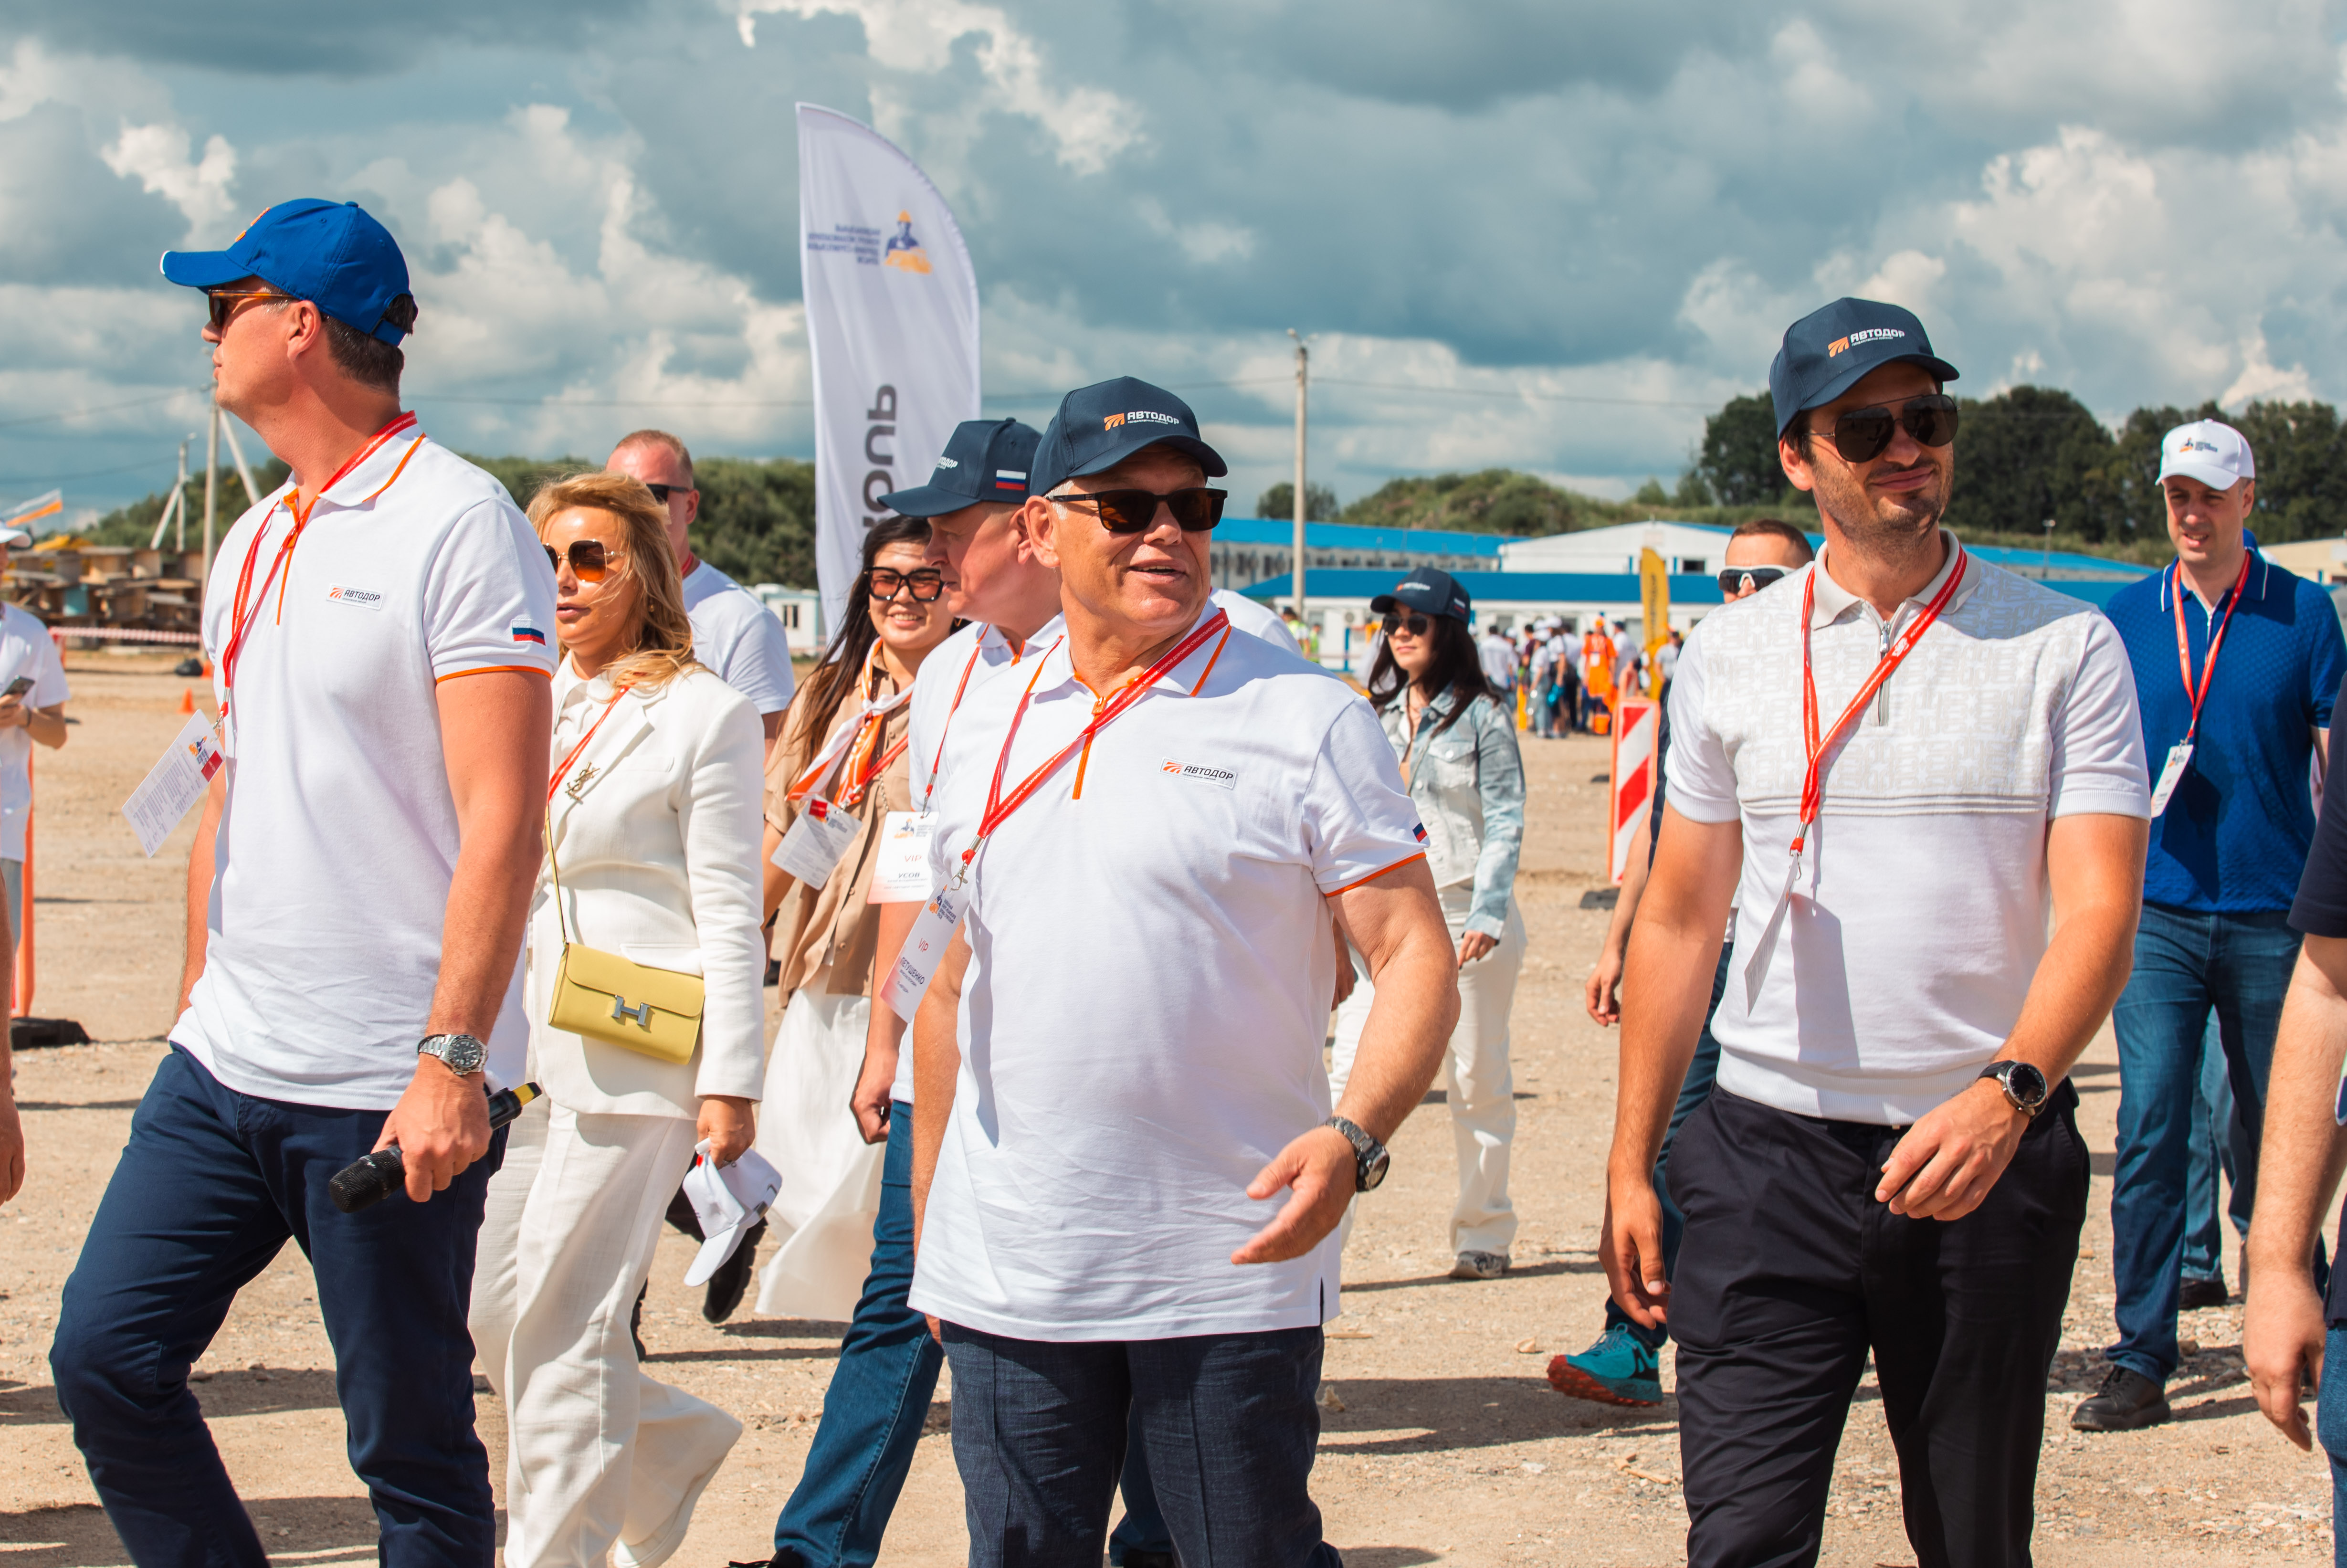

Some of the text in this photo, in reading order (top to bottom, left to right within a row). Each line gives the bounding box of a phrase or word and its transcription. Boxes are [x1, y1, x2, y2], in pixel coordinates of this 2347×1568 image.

[1850, 328, 1905, 343] АВТОДОР
[1127, 411, 1179, 425] АВТОДОР
[344, 589, 380, 601] АВТОДОР
[1095, 698, 1127, 726] НАЦИОНАЛЬНЫЙ
[1127, 683, 1144, 700] КОНКУРС
[1143, 659, 1173, 684] МЕХАНИЗАТОРОВ
[1184, 766, 1233, 779] АВТОДОР
[1007, 789, 1024, 807] КОНКУРС
[1023, 759, 1053, 790] МЕХАНИЗАТОРОВ
[918, 937, 928, 952] VIP
[900, 957, 925, 984] ПЕТУШЕНКО
